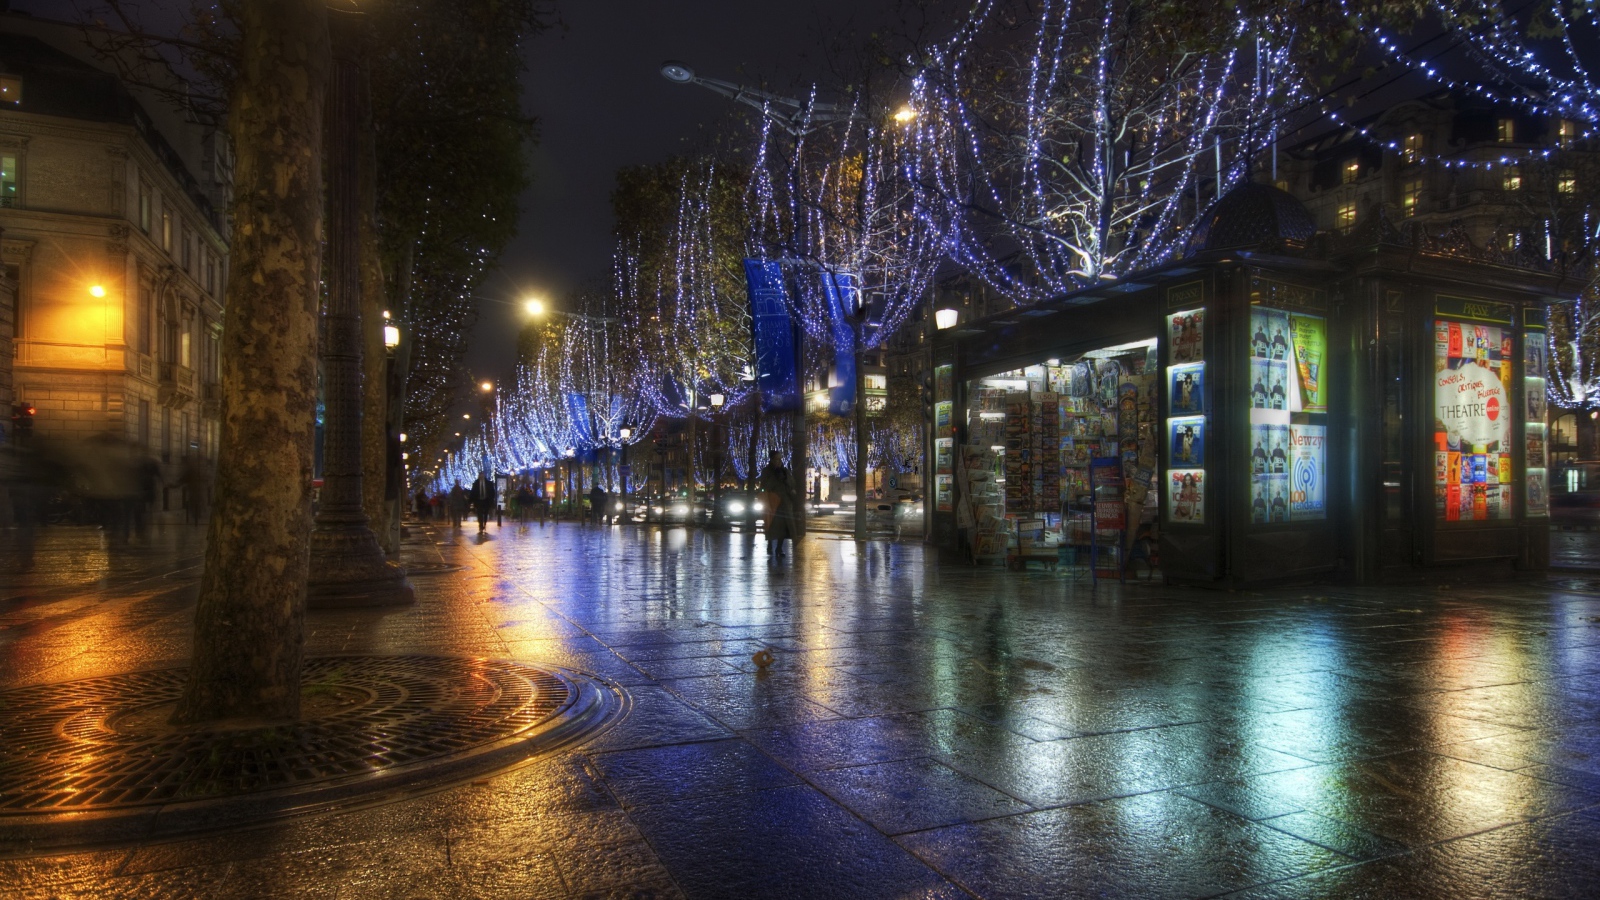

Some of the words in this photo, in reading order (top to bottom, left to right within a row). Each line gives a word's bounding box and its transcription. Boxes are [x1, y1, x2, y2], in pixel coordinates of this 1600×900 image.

[1463, 303, 1490, 316] PRESSE
[1173, 313, 1202, 326] Stff
[1176, 373, 1200, 381] Stff
[1440, 403, 1485, 419] THEATRE
[1176, 425, 1201, 434] Stff
[1288, 429, 1323, 449] Newzy
[1172, 472, 1202, 482] Stff
